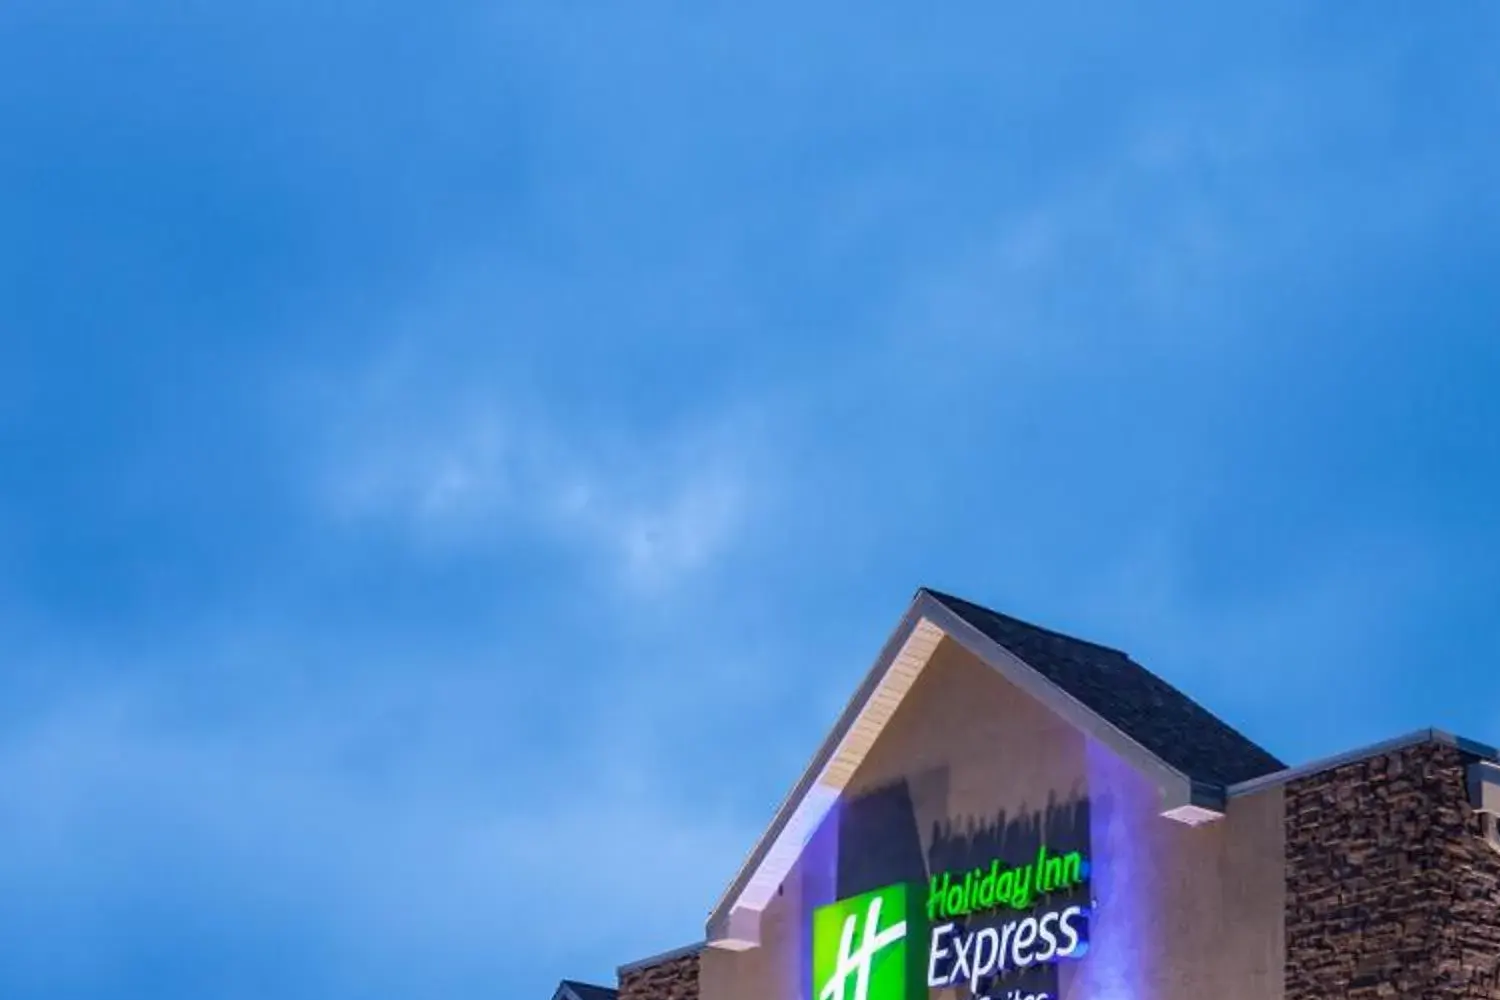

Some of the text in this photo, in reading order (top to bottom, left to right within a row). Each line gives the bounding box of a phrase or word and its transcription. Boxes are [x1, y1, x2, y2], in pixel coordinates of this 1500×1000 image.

[927, 846, 1082, 920] Holiday Inn
[928, 905, 1081, 993] Express
